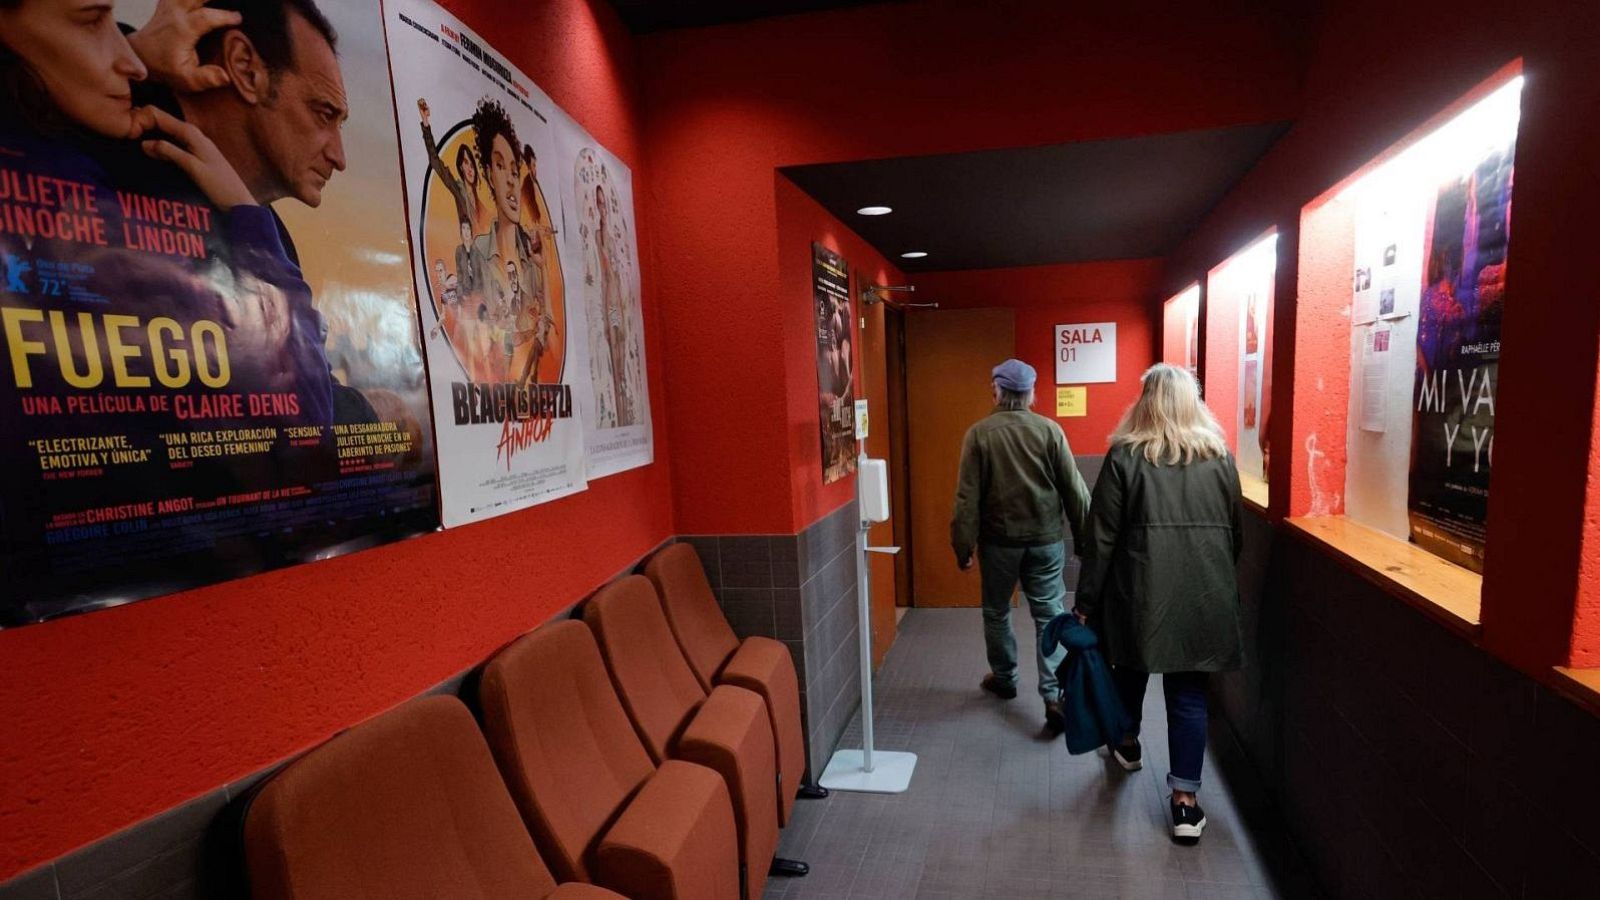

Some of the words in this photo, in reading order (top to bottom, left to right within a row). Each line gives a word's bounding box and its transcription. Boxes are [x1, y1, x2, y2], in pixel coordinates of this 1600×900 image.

[117, 190, 210, 232] VINCENT
[122, 222, 206, 259] LINDON
[1, 307, 231, 388] FUEGO
[1061, 328, 1103, 344] SALA
[1060, 347, 1076, 362] 01
[452, 382, 518, 426] BLACK
[1418, 369, 1448, 413] MI
[1457, 368, 1495, 416] VA
[22, 396, 62, 415] UNA
[68, 392, 146, 414] PELÍCULA
[150, 396, 169, 412] DE
[174, 394, 244, 420] CLAIRE
[250, 394, 300, 416] DENIS
[190, 430, 214, 444] RICA
[216, 426, 277, 443] EXPLORACIÓN
[336, 434, 366, 447] JULIETTE
[366, 432, 394, 444] BINOCHE
[394, 432, 402, 442] EN
[402, 432, 411, 441] UN
[1444, 423, 1460, 468] Y
[1472, 426, 1494, 472] Y
[40, 452, 98, 470] EMOTIVA
[100, 450, 110, 465] Y
[168, 446, 189, 460] DEL
[192, 444, 222, 458] DESEO
[338, 446, 374, 458] LABERINTO
[374, 445, 383, 455] DE
[86, 502, 155, 523] CHRISTINE
[158, 497, 194, 514] ANGOT
